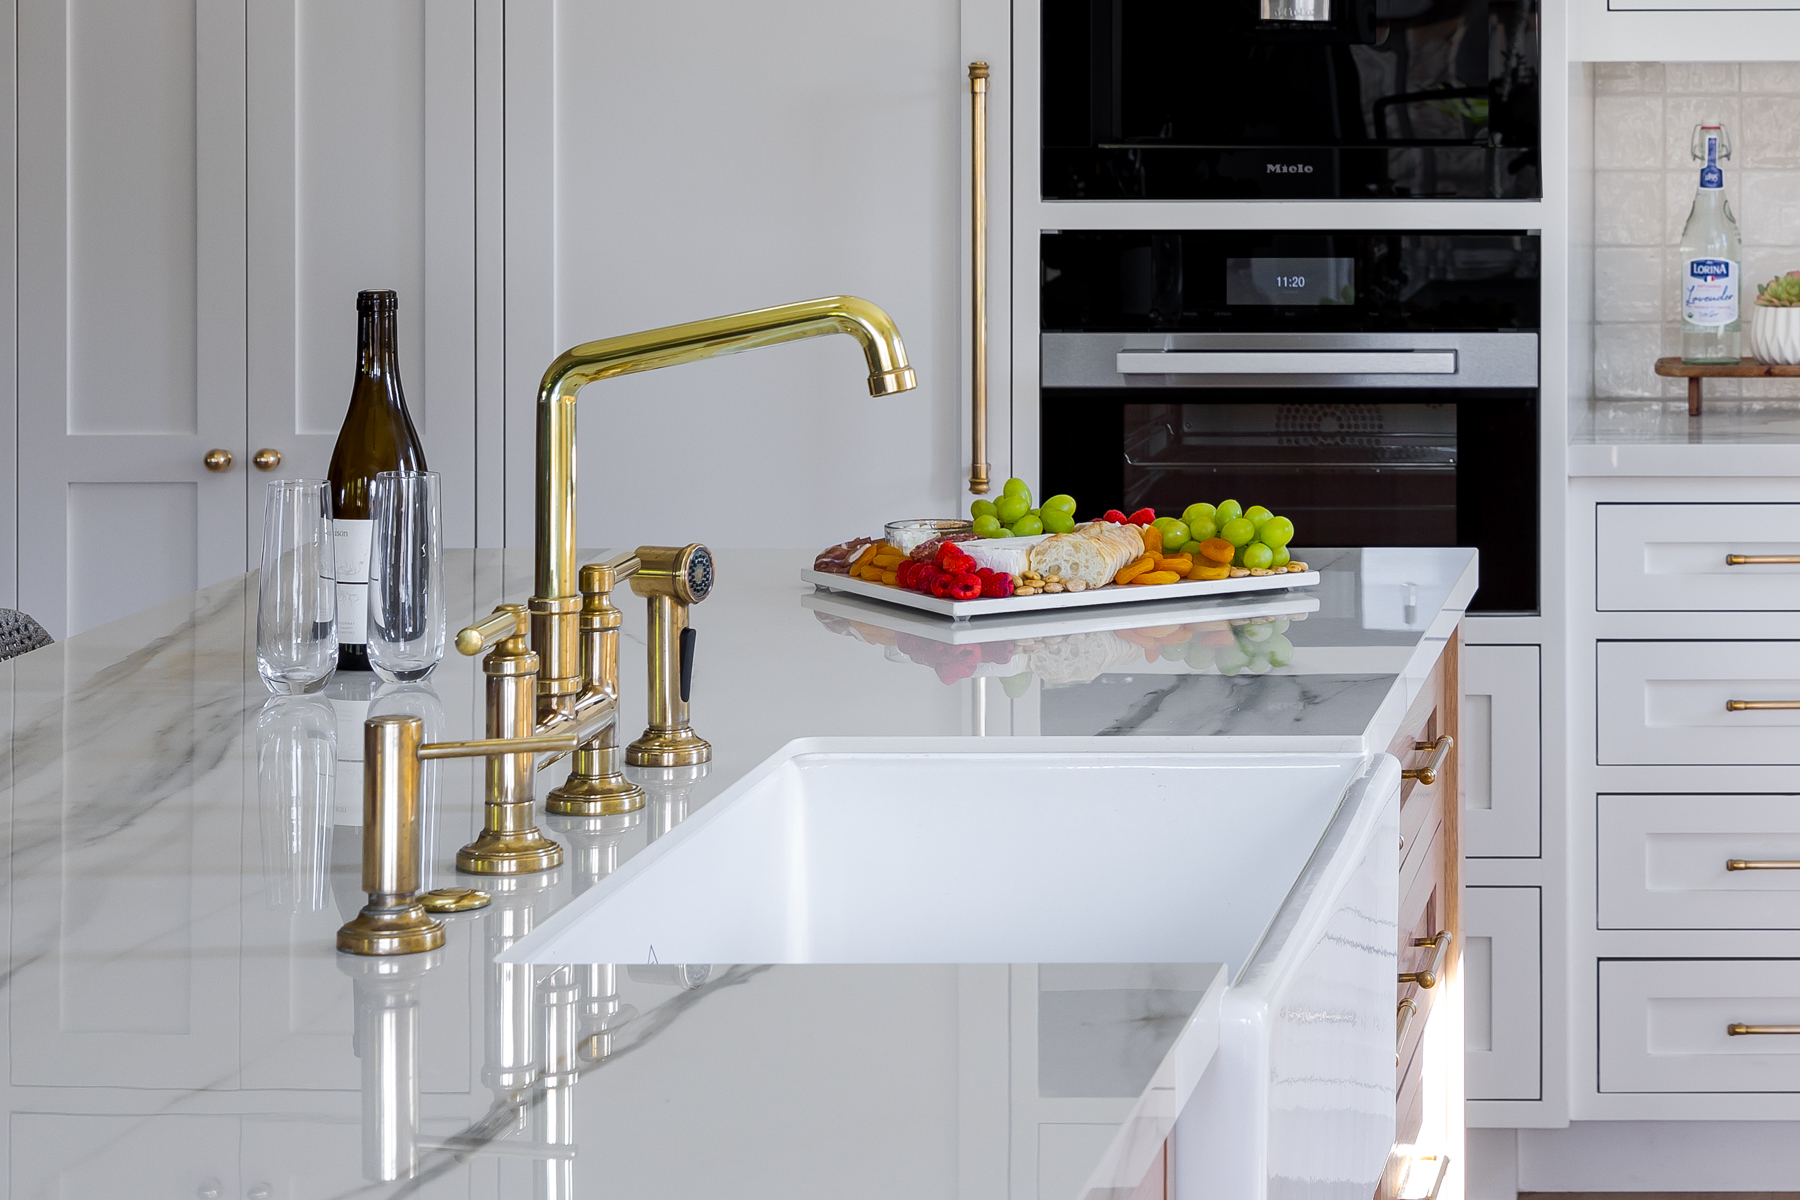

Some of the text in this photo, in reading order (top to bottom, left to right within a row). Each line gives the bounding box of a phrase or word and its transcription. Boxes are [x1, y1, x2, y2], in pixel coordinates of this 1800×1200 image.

[1266, 163, 1314, 174] Miele
[1693, 264, 1728, 275] LORINA
[1276, 275, 1306, 288] 11:20
[1686, 285, 1734, 307] Lavender
